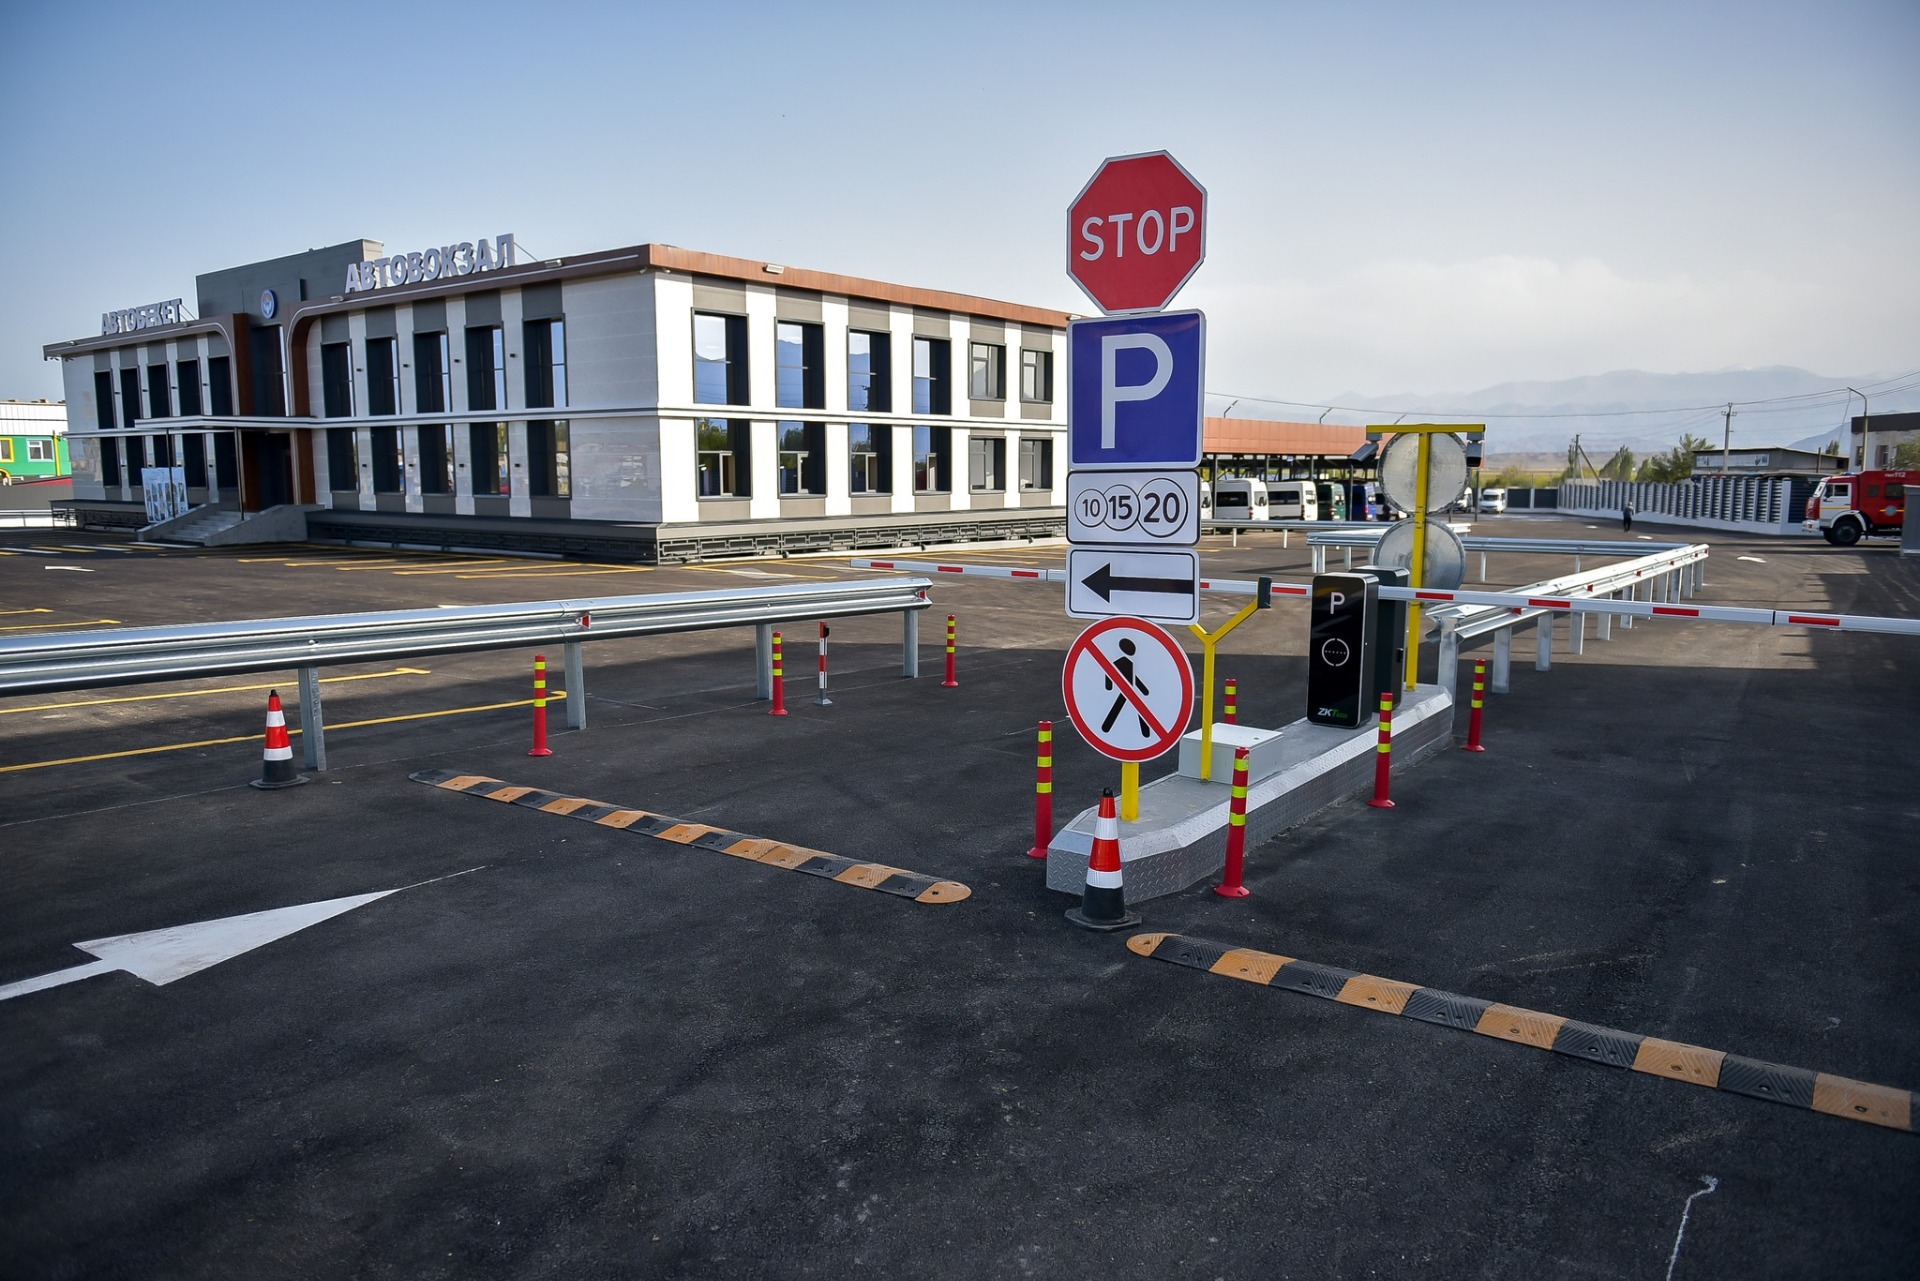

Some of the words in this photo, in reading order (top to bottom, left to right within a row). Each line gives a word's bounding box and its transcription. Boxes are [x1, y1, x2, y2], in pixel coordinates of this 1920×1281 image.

[1080, 205, 1195, 261] STOP
[344, 233, 515, 294] АВТОВОКЗАЛ
[101, 298, 182, 335] АВТОБЕКЕТ
[1101, 332, 1174, 449] P
[1082, 498, 1101, 518] 10
[1108, 495, 1133, 520] 15
[1143, 492, 1180, 524] 20
[1330, 591, 1345, 615] P
